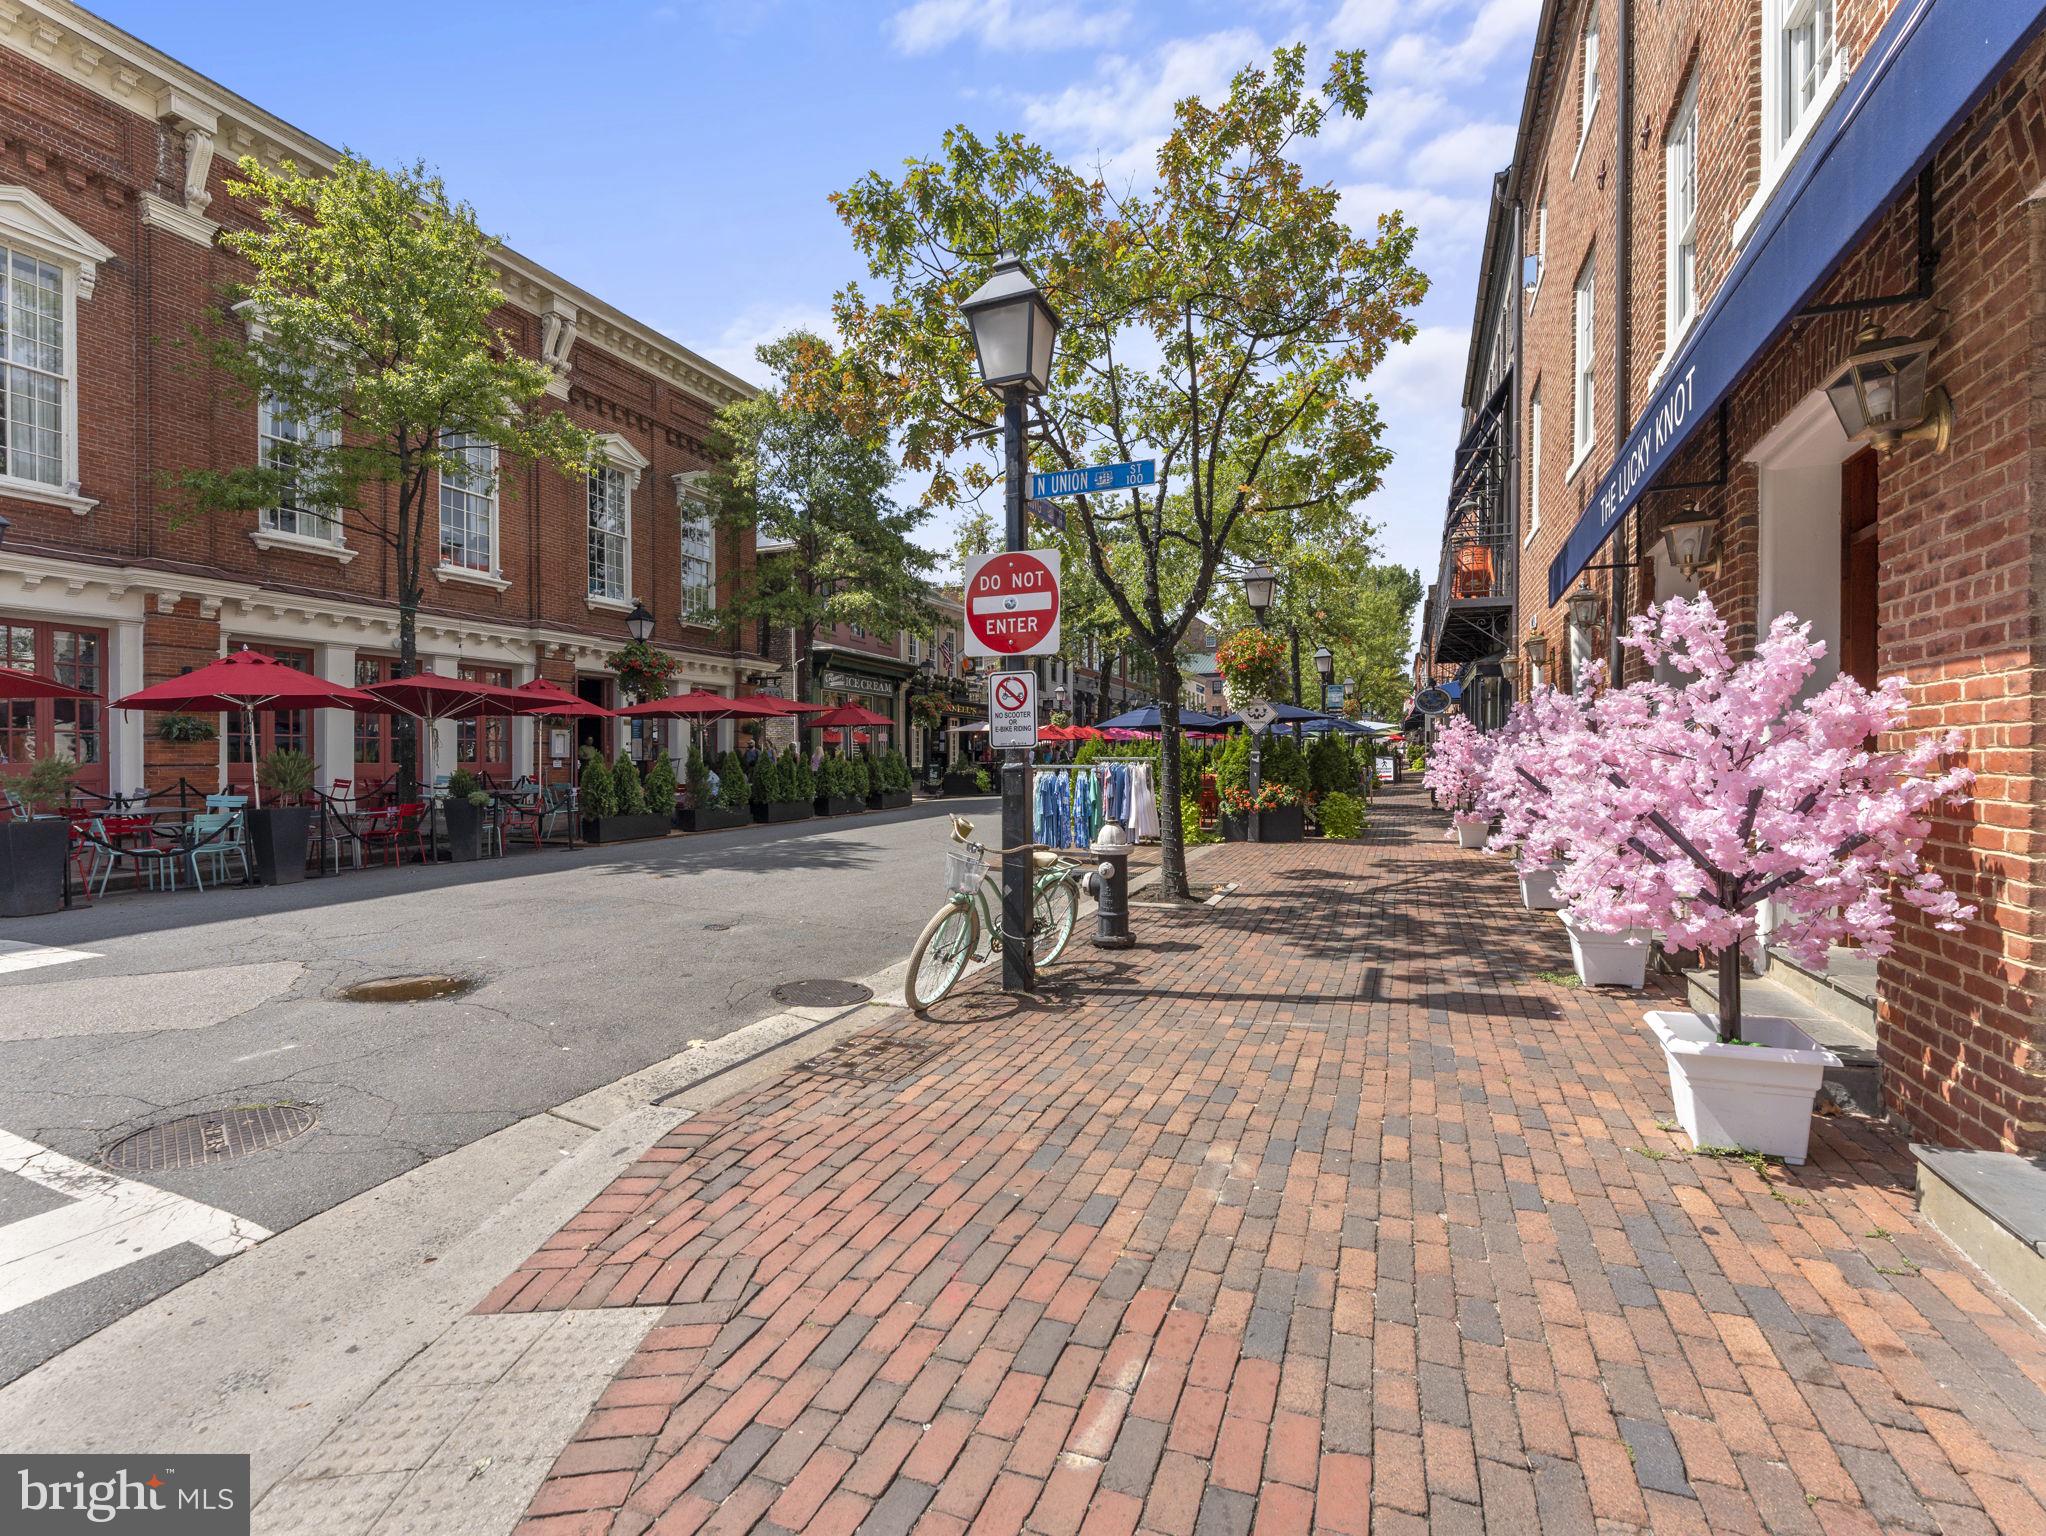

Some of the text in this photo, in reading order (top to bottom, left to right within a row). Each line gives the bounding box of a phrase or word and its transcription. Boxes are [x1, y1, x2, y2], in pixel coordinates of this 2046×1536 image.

[1600, 365, 1696, 527] THE LUCKY KNOT
[1037, 464, 1142, 496] N UNION ST
[1126, 473, 1143, 485] 100
[980, 570, 1045, 592] DO NOT
[986, 617, 1038, 635] ENTER
[845, 676, 860, 688] ICE
[860, 679, 892, 693] CREAM
